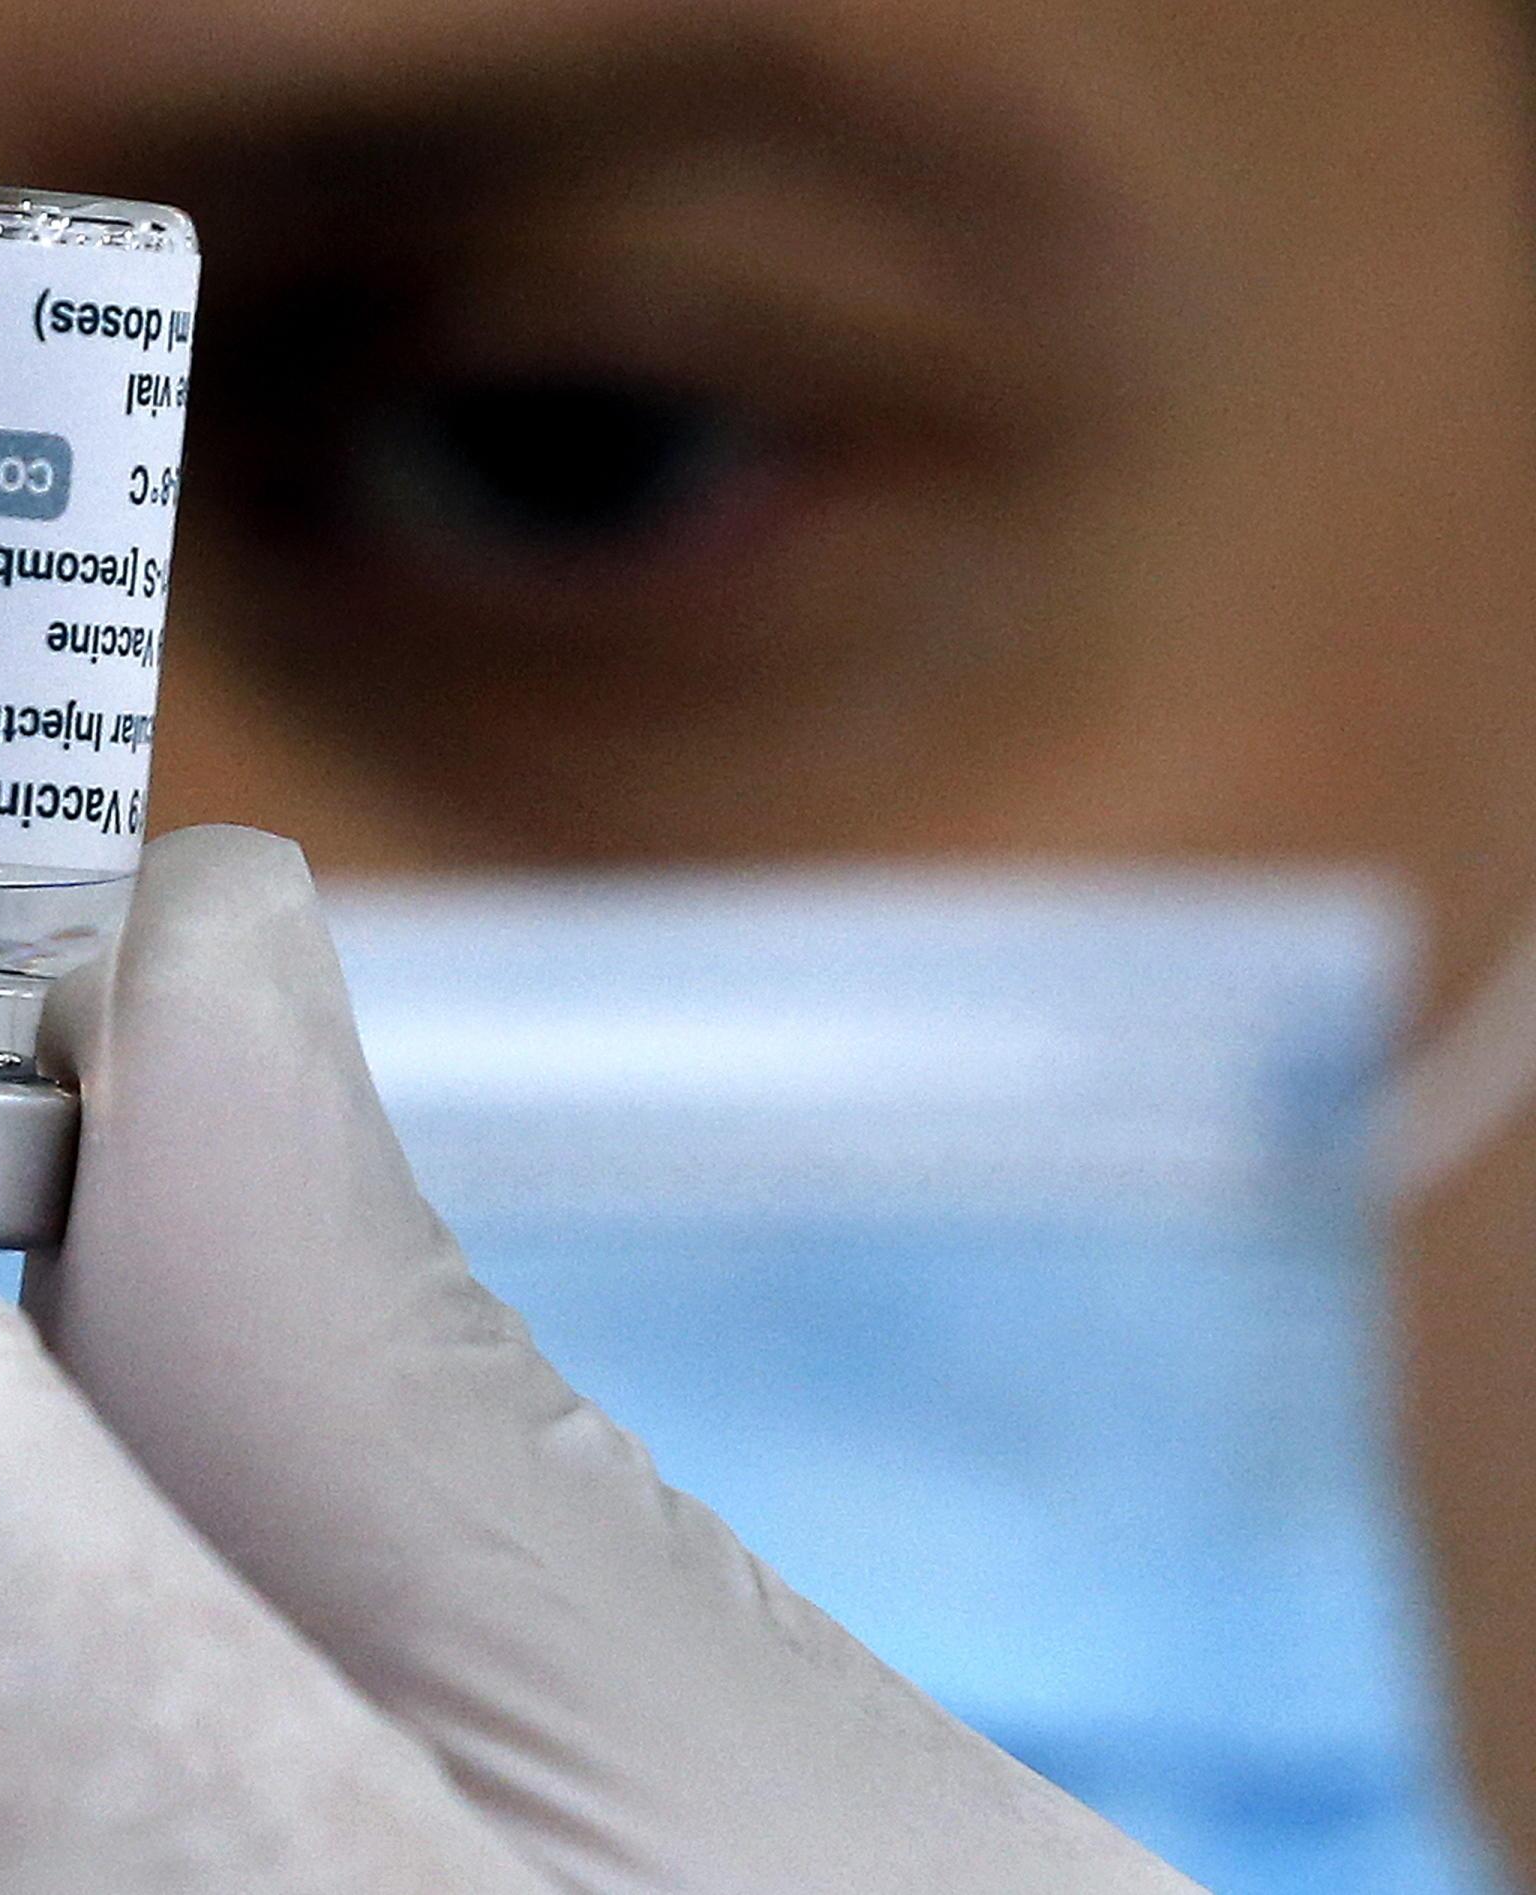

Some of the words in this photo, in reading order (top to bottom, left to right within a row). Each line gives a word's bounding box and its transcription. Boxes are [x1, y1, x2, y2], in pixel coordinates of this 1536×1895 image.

[33, 287, 163, 353] doses)
[126, 372, 171, 418] vial
[45, 620, 154, 668] Vaccine
